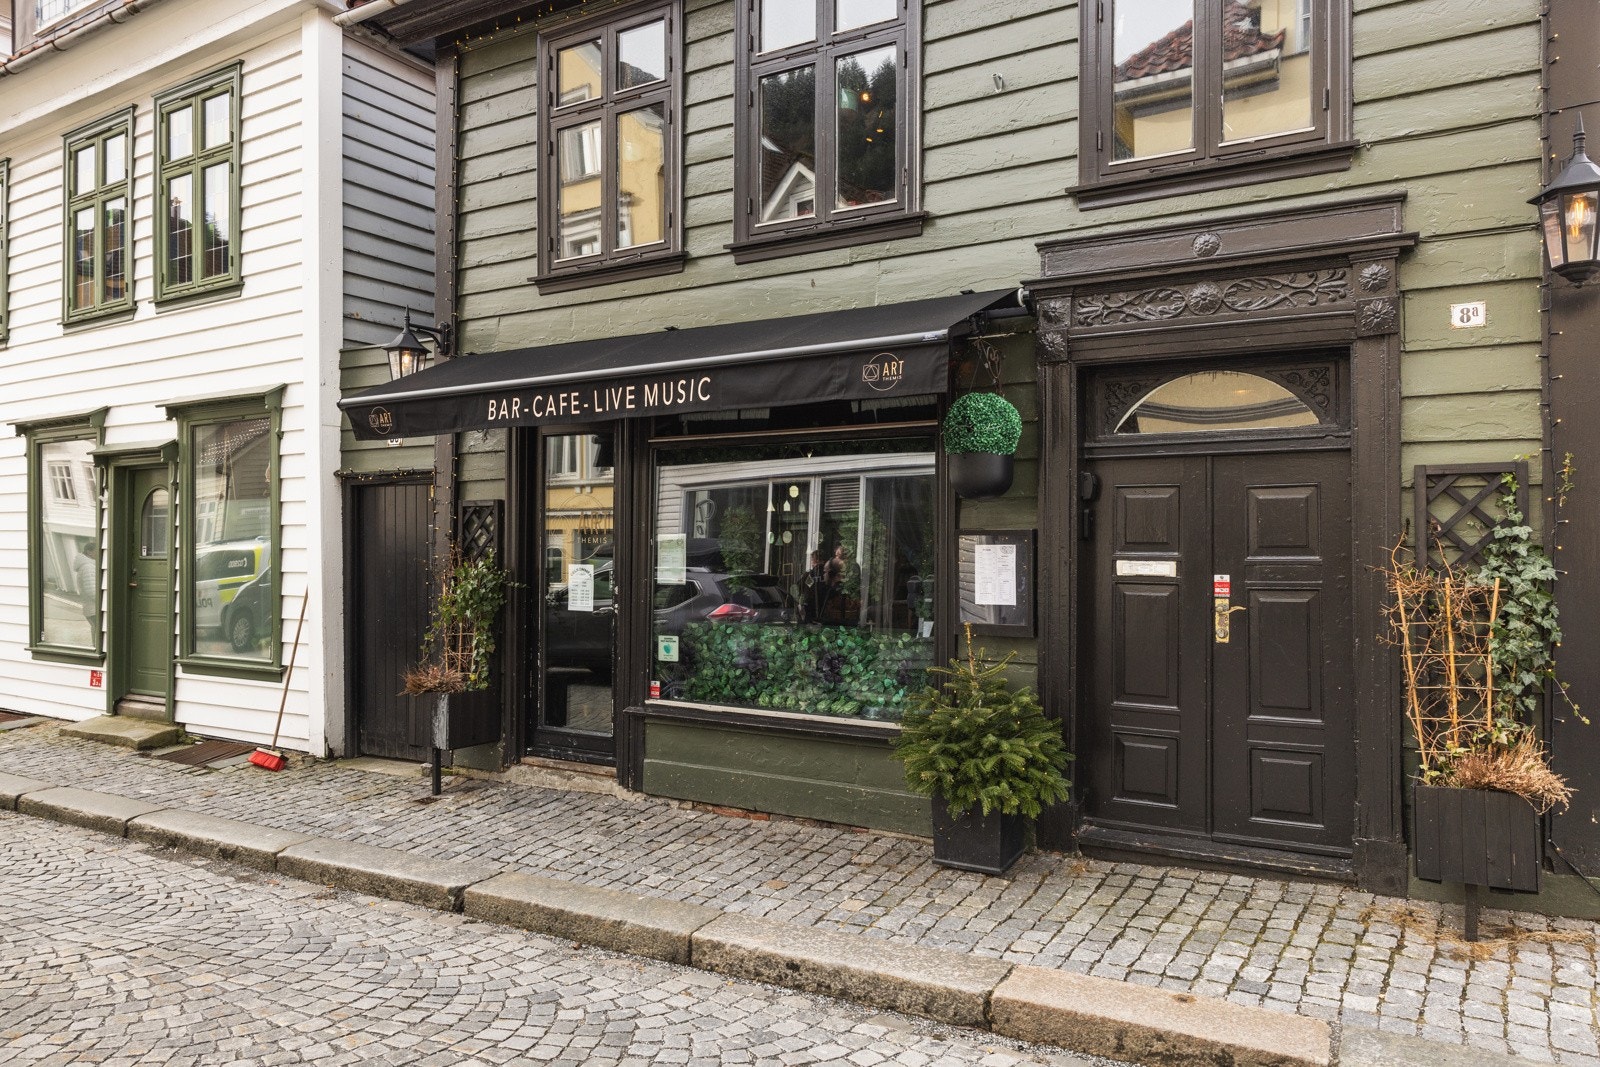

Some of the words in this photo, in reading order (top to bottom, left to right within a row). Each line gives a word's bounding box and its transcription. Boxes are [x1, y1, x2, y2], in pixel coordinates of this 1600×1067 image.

[882, 360, 905, 377] ART
[882, 374, 903, 382] THEMIS
[643, 376, 712, 408] MUSIC
[379, 412, 393, 424] ART
[577, 536, 608, 544] THEMIS
